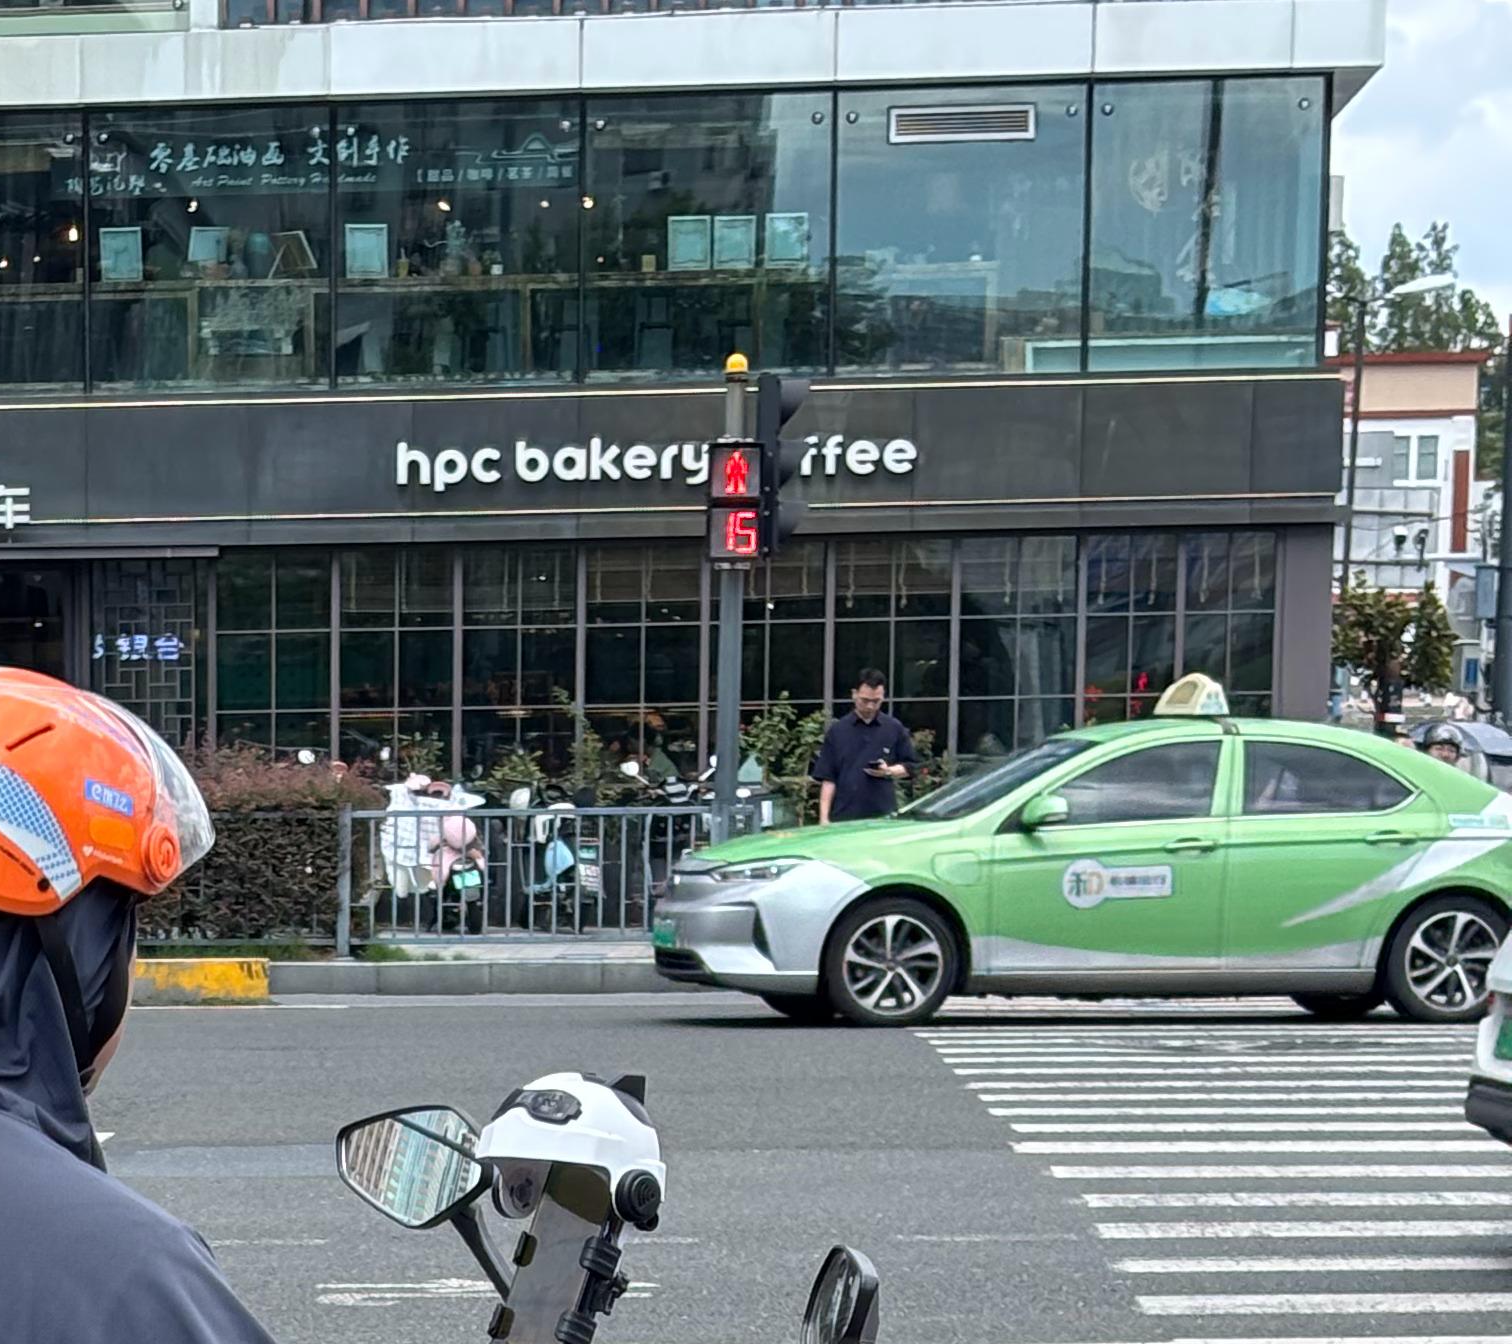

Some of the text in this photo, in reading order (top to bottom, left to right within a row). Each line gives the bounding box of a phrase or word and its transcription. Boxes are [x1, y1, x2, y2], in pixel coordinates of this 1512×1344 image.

[396, 434, 918, 492] hpc bakery ffee
[727, 511, 756, 554] 15
